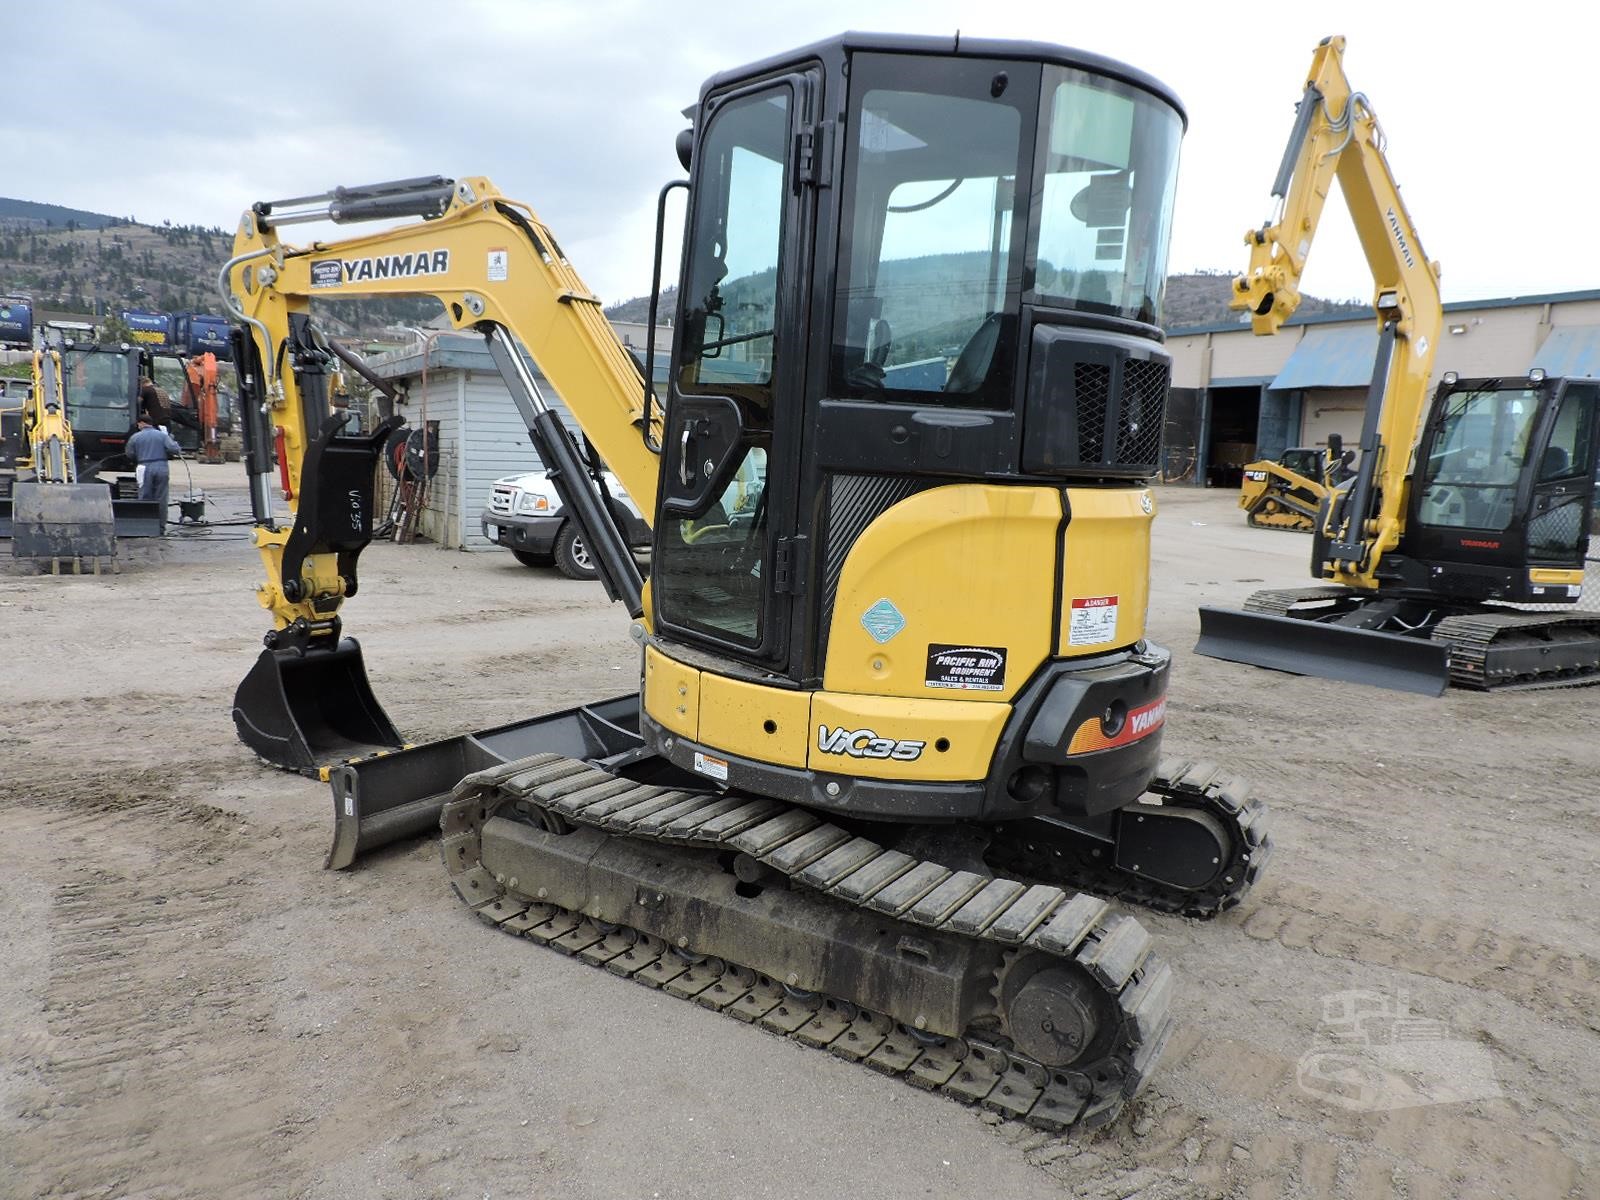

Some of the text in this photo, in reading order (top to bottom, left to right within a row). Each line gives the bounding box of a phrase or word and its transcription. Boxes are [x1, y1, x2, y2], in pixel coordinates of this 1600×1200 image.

[1386, 207, 1415, 269] YANMAR
[343, 250, 449, 282] YANMAR
[936, 656, 998, 668] PACIFIC RIM
[949, 667, 996, 676] EQUIPMENT
